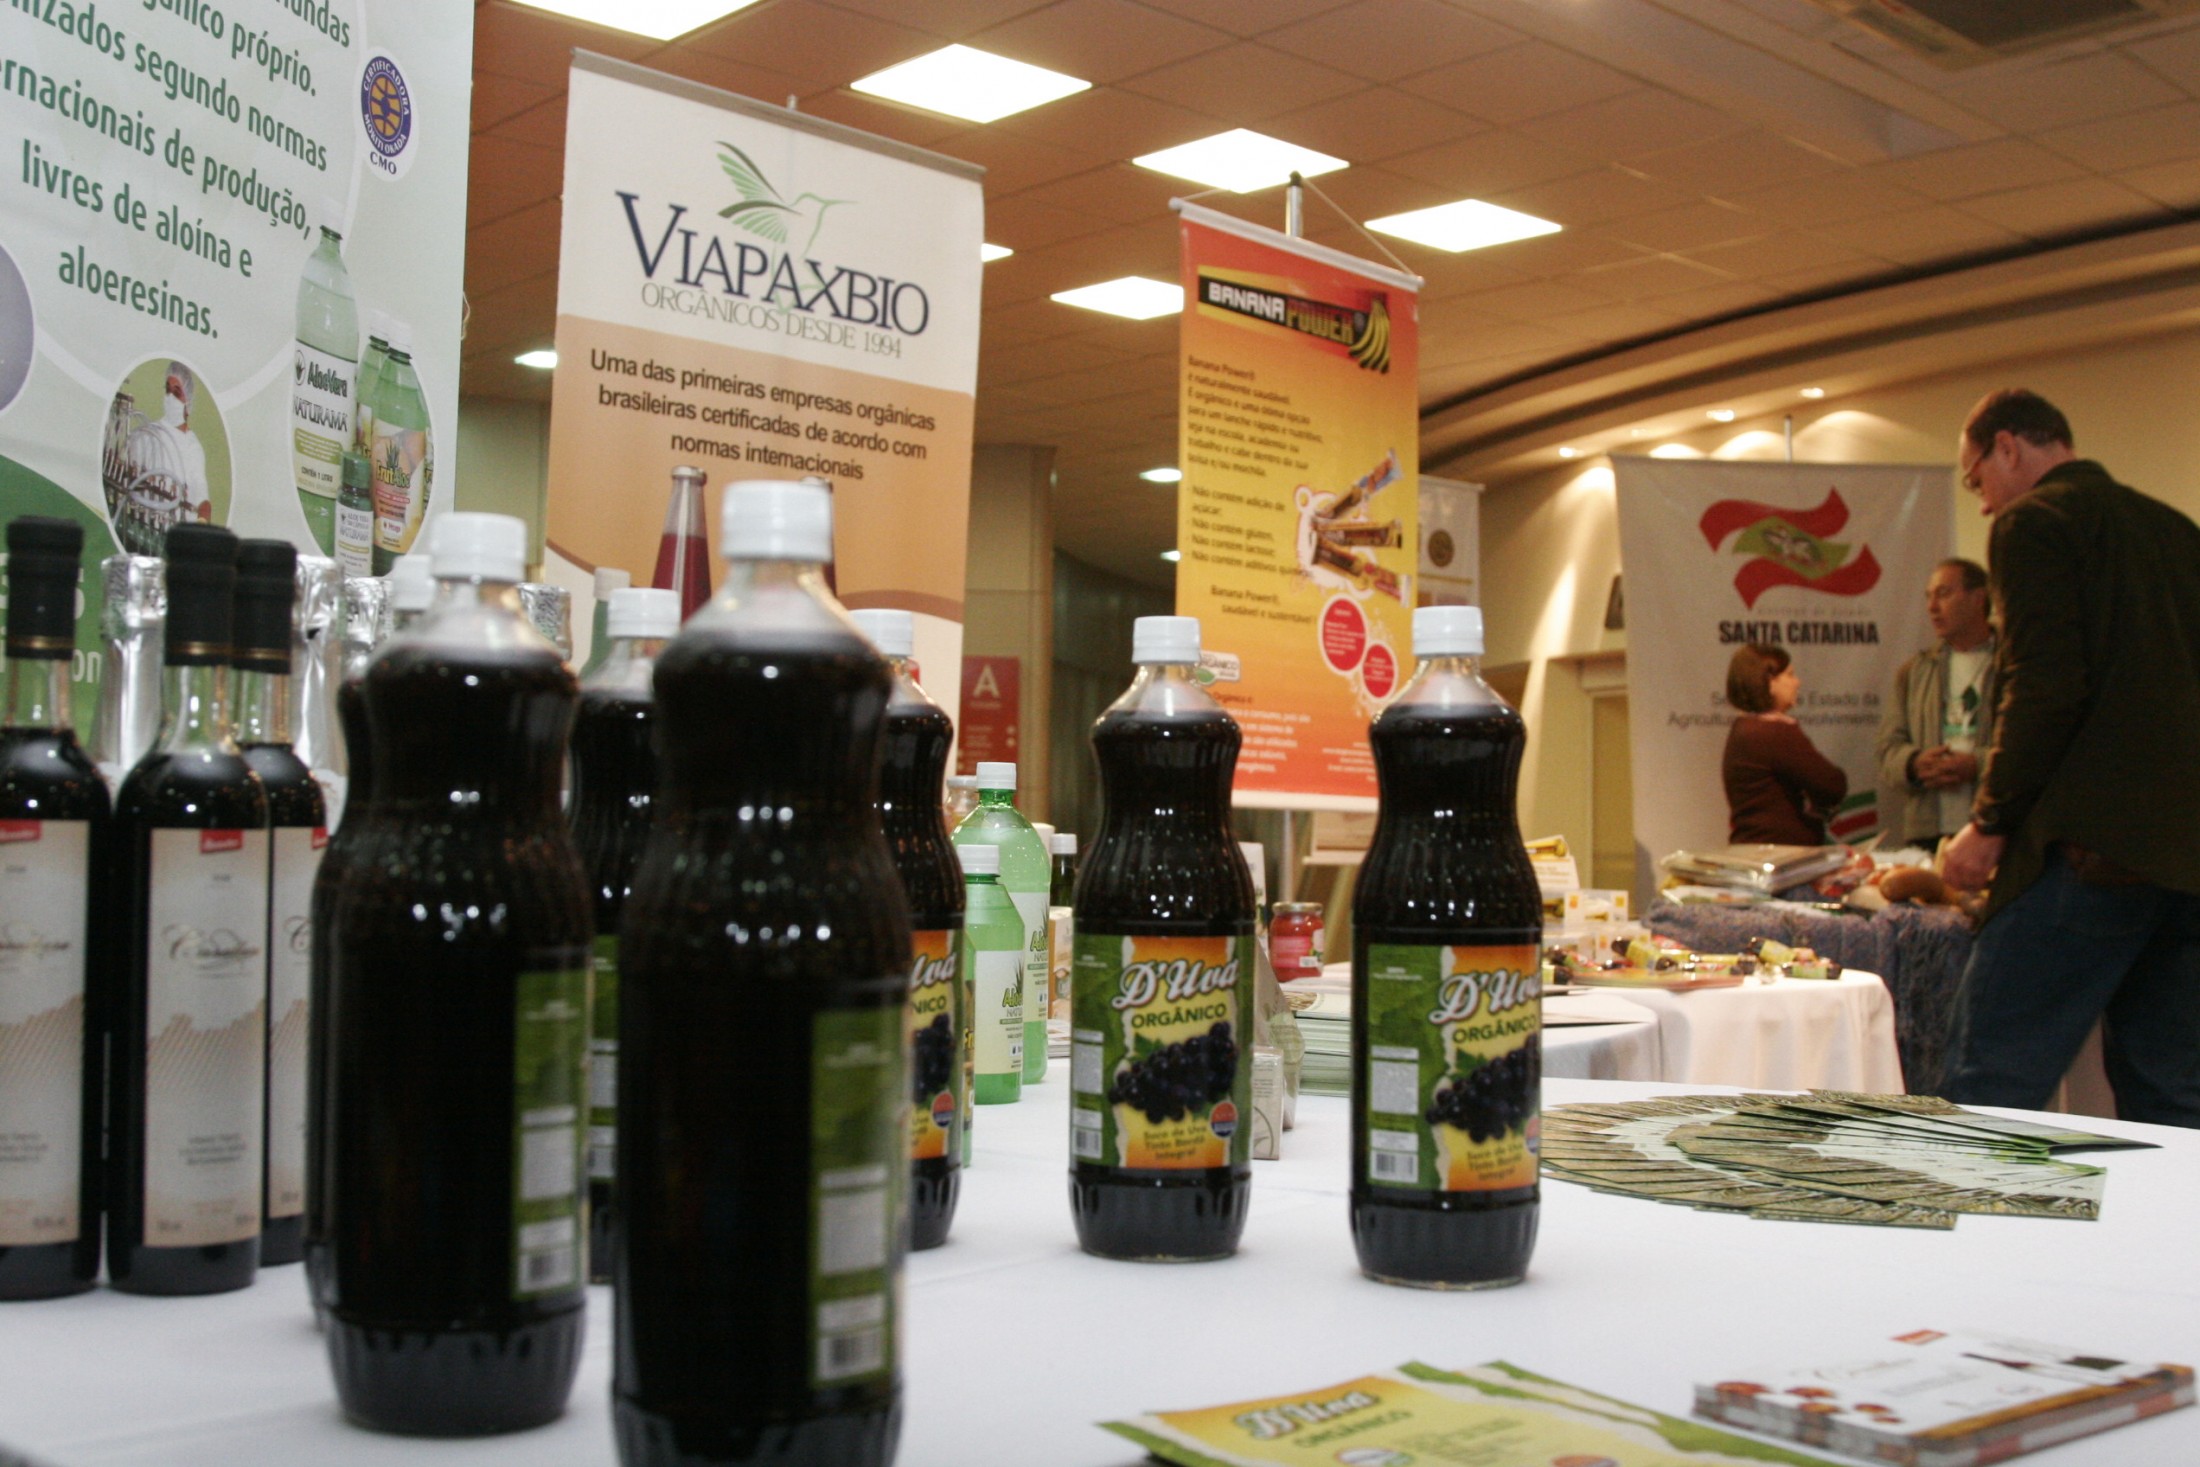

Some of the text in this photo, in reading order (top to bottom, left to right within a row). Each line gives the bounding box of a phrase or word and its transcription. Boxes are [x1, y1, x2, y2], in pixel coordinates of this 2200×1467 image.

[231, 22, 316, 97] próprio.
[134, 42, 240, 124] segundo
[248, 105, 328, 172] normas
[0, 58, 312, 241] rnacionais de produção,
[369, 150, 398, 176] CMO
[22, 138, 253, 279] livres de aloína e
[58, 244, 219, 340] aloeresinas.
[641, 281, 902, 359] ORGÂNICOS DESDE 1994
[1208, 281, 1286, 323] BANANA
[590, 348, 936, 433] Uma das primeiras empresas orgânicas
[598, 384, 927, 460] brasileiras certificadas de acordo com
[670, 431, 864, 480] normas internacionais
[1719, 620, 1879, 645] SANTA CATARINA
[972, 663, 1000, 698] A
[1112, 959, 1240, 1010] D'Uva
[1131, 1004, 1228, 1029] ORGÂNICO
[1452, 1015, 1537, 1044] ORGÂNICO
